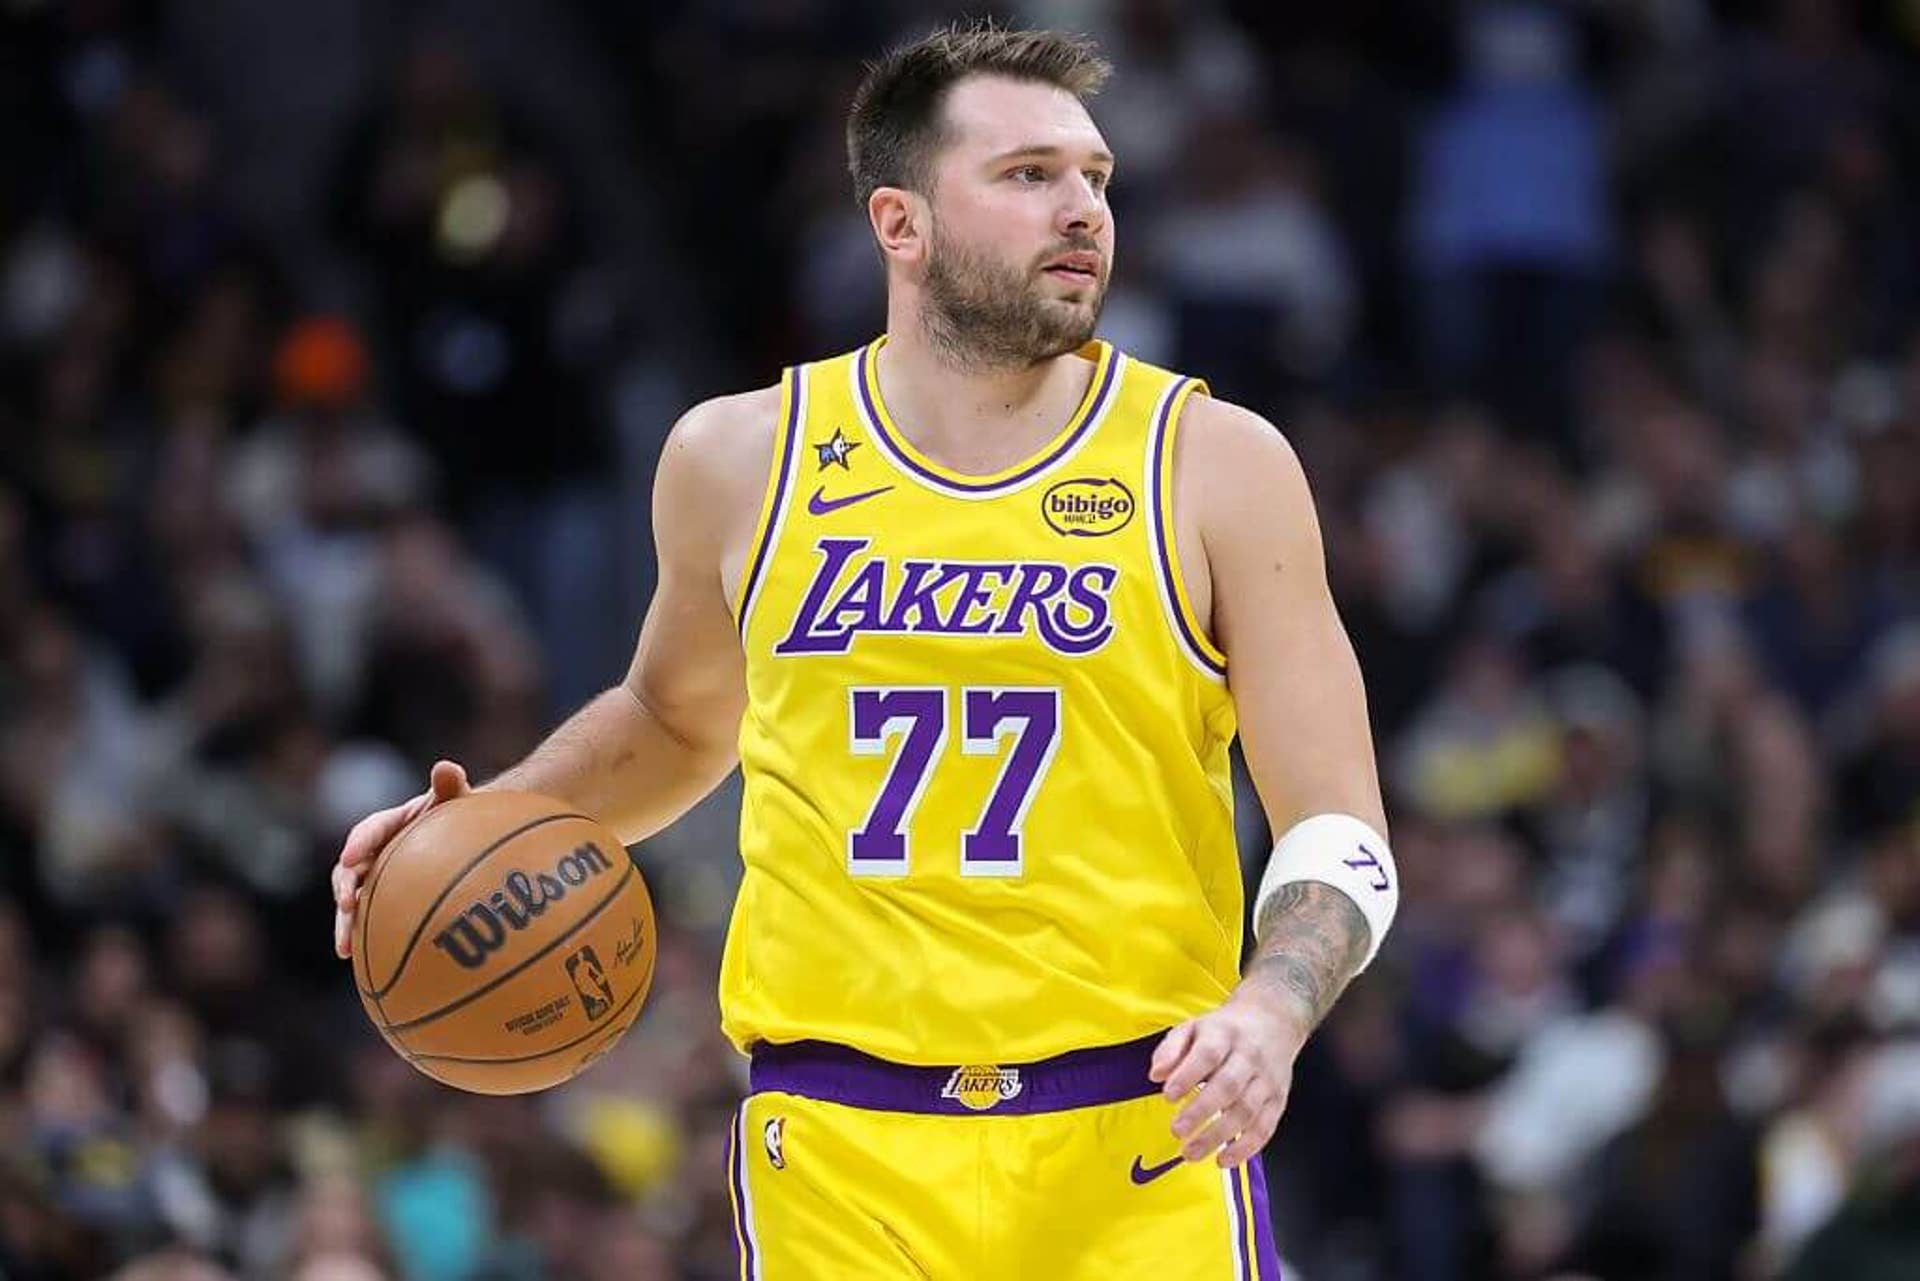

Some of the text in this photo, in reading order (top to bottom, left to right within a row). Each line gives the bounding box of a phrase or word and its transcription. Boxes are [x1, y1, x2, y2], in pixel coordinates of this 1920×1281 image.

[1051, 494, 1129, 520] bibigo
[774, 537, 1119, 657] LAKERS
[848, 686, 1061, 875] 77
[432, 841, 613, 969] Wilson
[941, 1069, 1022, 1100] LAKERS
